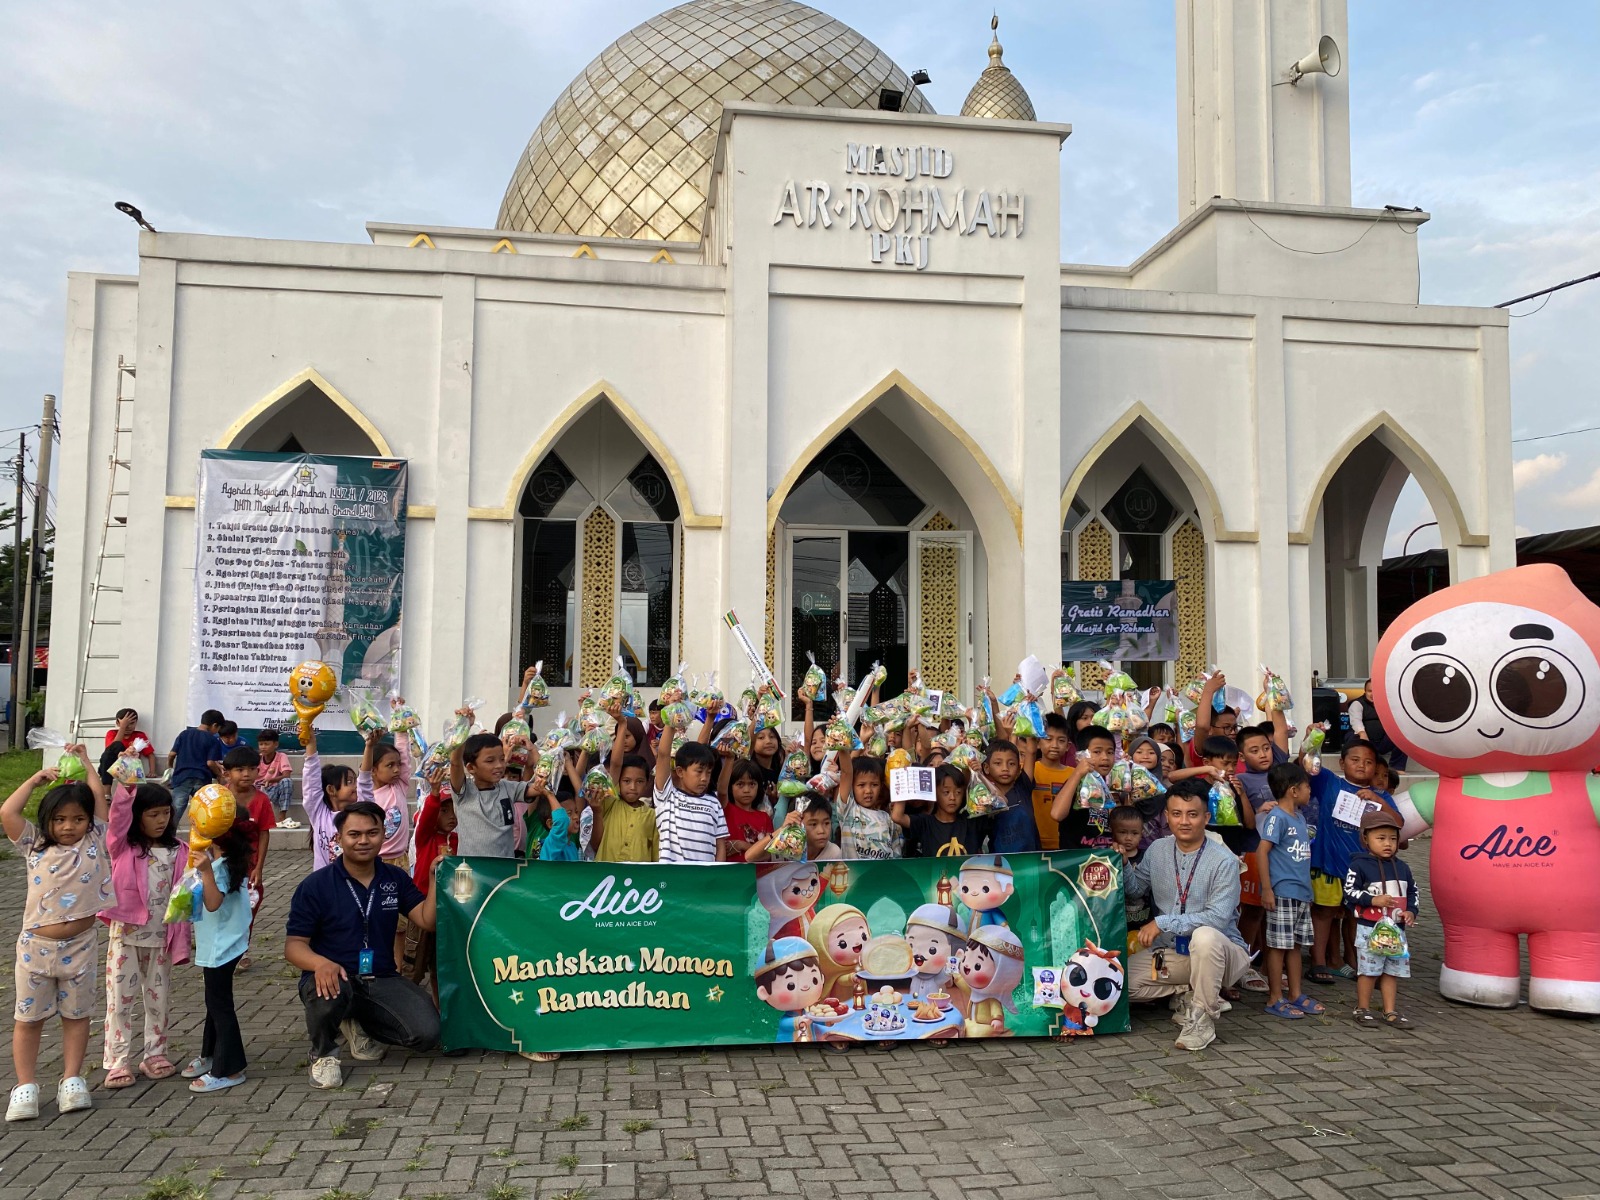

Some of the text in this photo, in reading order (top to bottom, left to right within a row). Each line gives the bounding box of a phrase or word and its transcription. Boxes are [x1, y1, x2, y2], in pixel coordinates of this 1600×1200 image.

[846, 142, 953, 181] MASJID
[871, 232, 930, 270] PKJ
[221, 482, 252, 498] Agenda
[254, 484, 289, 500] Kegiatan
[254, 500, 280, 516] Masjid
[216, 522, 240, 532] Takjil
[216, 534, 244, 542] Shalat
[212, 605, 258, 614] Peringatan
[1068, 604, 1104, 622] Gratis
[1107, 604, 1170, 618] Ramadhan
[212, 617, 250, 626] Kegiatan
[1074, 622, 1104, 636] Masjid
[1105, 622, 1156, 634] Ar-Rohmah
[212, 652, 249, 661] Kegiatan
[250, 652, 288, 662] Takbiran
[212, 664, 240, 672] Shalat
[1287, 826, 1298, 836] 22
[1460, 824, 1557, 860] Aice
[1085, 872, 1108, 881] Halal
[559, 875, 663, 921] Aice
[492, 947, 734, 984] Maniskan Momen
[537, 981, 691, 1014] Ramadhan
